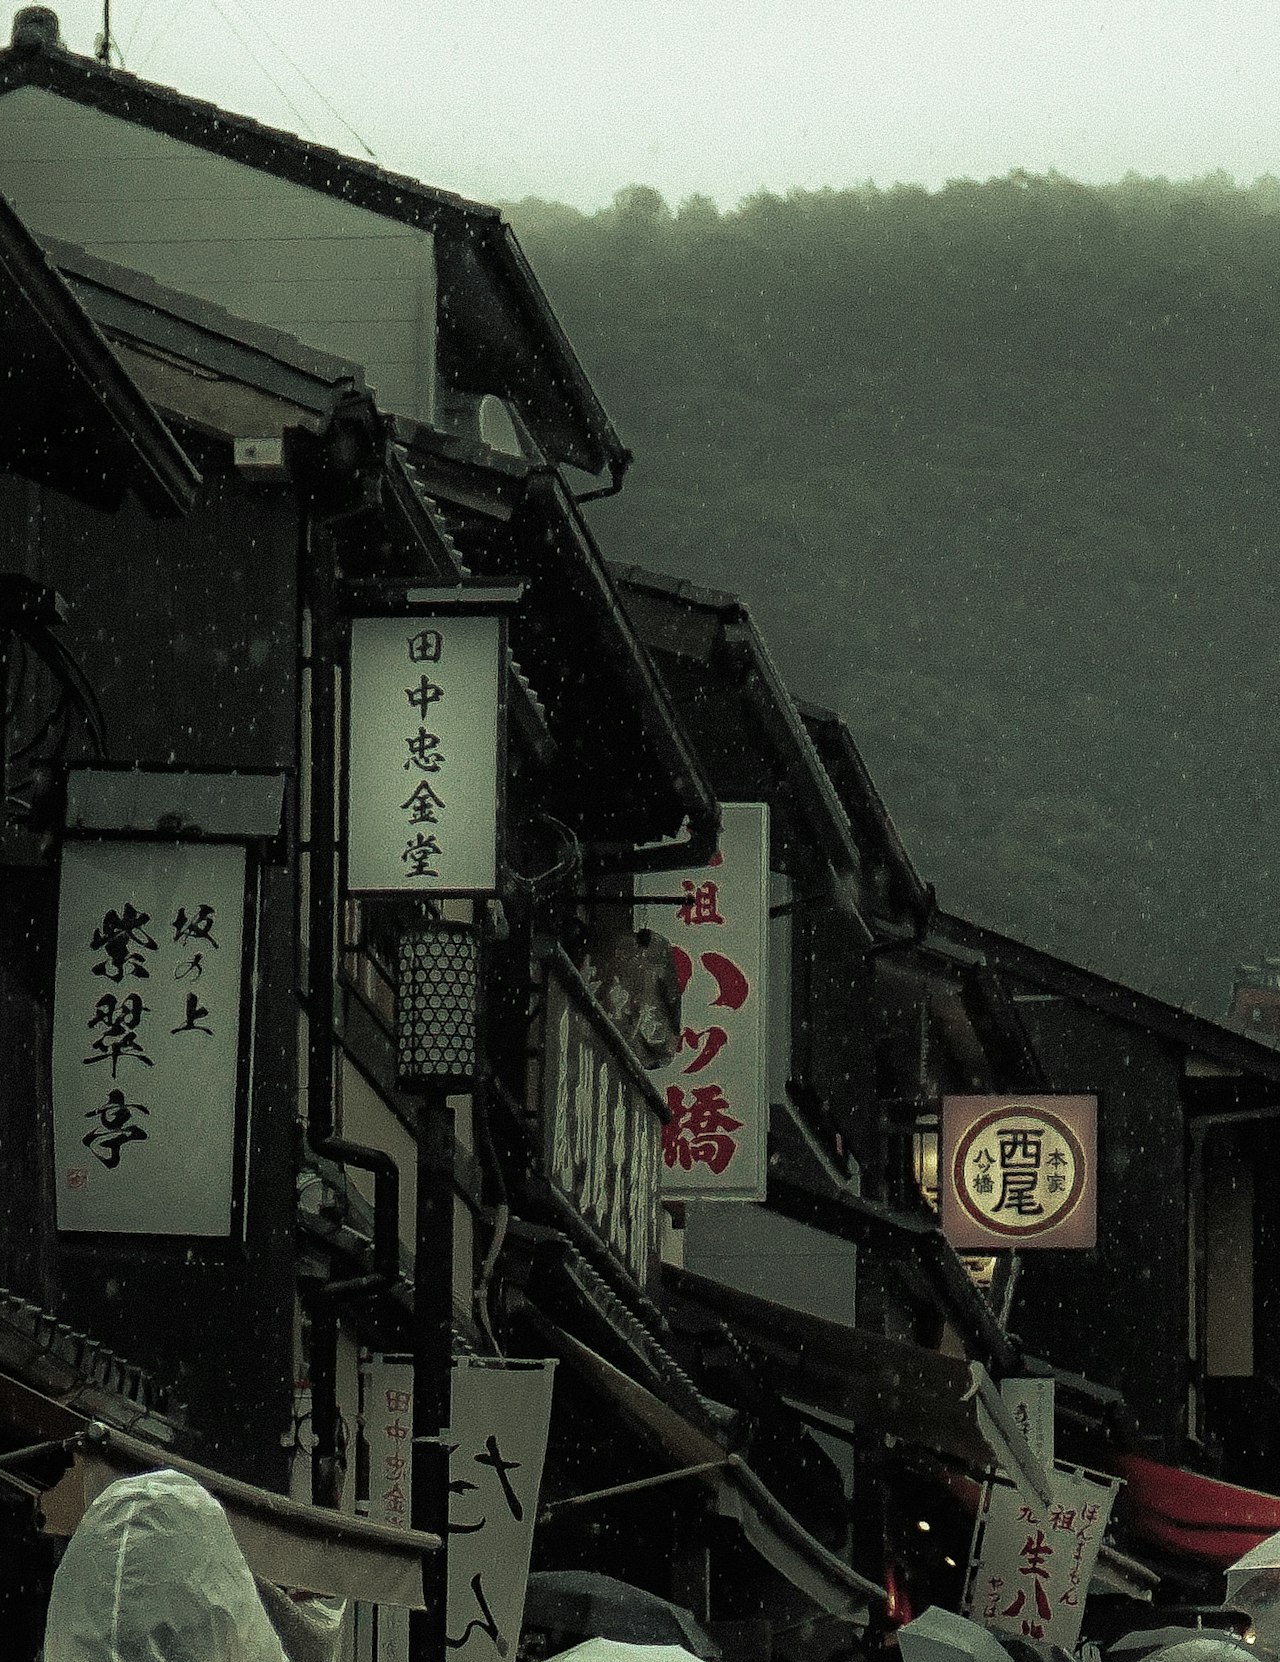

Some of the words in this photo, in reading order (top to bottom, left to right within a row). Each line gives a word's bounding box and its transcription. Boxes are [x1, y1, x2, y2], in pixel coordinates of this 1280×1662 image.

[171, 903, 220, 1038] 坂の上
[82, 902, 159, 1171] 紫翠亭
[990, 1128, 1046, 1216] 西尾
[1046, 1148, 1069, 1194] 本家
